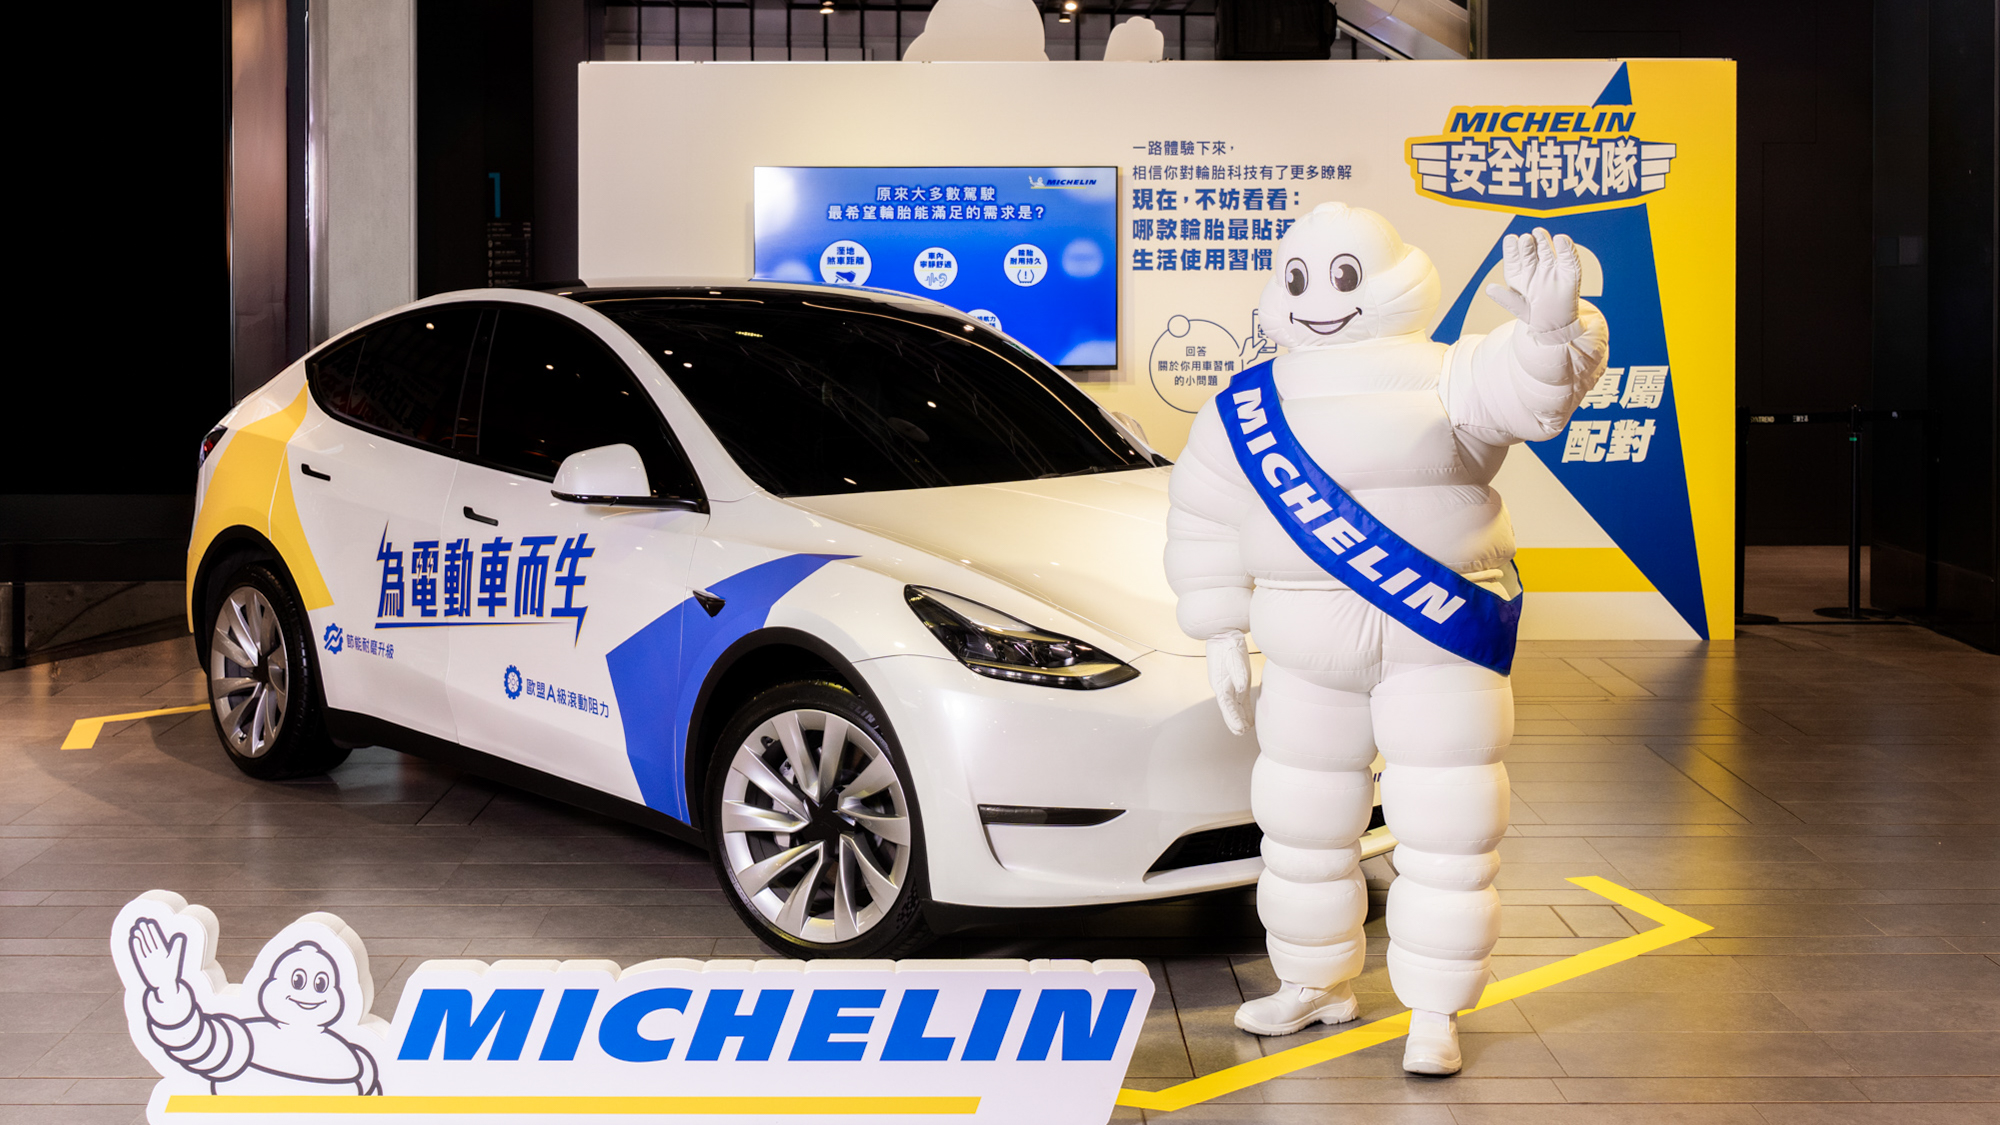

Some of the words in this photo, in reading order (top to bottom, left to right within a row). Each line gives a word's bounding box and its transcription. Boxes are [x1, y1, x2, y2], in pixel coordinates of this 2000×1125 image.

[1450, 112, 1637, 133] MICHELIN
[1132, 140, 1235, 156] 一路體驗下來，
[1132, 165, 1352, 180] 相信你對輪胎科技有了更多瞭解
[1450, 138, 1638, 198] 安全特攻隊
[488, 172, 501, 218] 1
[876, 186, 996, 202] 原來大多數駕駛
[1132, 248, 1273, 271] 生活使用習慣
[1185, 346, 1207, 357] 回答
[1157, 360, 1235, 372] 關於你用車習慣
[1174, 375, 1218, 386] 的小問題
[1561, 419, 1657, 463] 配對
[1232, 387, 1467, 625] MICHELIN
[376, 520, 596, 647] 為電動車而生
[346, 634, 395, 659] 節能耐磨升級
[526, 678, 609, 719] 歐盟A級滾動阻力
[396, 987, 1137, 1063] MICHELIN
